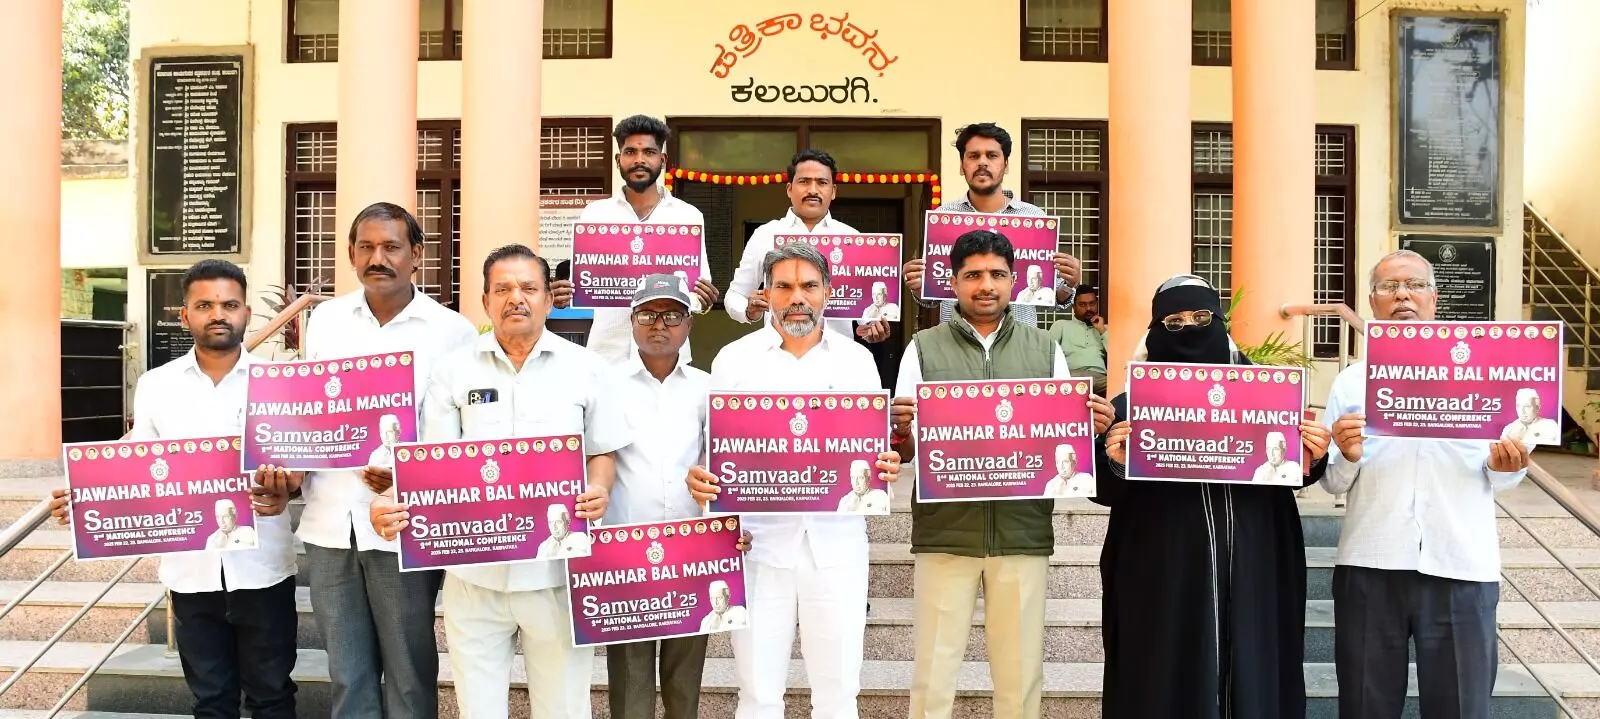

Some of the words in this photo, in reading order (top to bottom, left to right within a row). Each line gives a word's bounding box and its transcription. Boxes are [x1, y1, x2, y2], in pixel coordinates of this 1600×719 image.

[575, 254, 630, 265] JAWAHAR
[633, 255, 653, 265] BAL
[656, 255, 698, 266] MANCH
[833, 266, 851, 276] BAL
[855, 266, 897, 277] MANCH
[1369, 365, 1448, 380] JAWAHAR
[1454, 366, 1483, 380] BAL
[1489, 367, 1555, 381] MANCH
[249, 401, 323, 416] JAWAHAR
[328, 399, 352, 413] BAL
[357, 392, 412, 410] MANCH
[1133, 406, 1206, 422] JAWAHAR
[1211, 409, 1237, 423] BAL
[1242, 410, 1299, 425] MANCH
[921, 425, 994, 441] JAWAHAR
[999, 424, 1026, 439] BAL
[1030, 422, 1088, 438] MANCH
[315, 443, 359, 452] CONFERENCE
[713, 438, 788, 453] JAWAHAR
[794, 438, 820, 452] BAL
[826, 438, 884, 452] MANCH
[989, 472, 1035, 480] CONFERENCE
[74, 484, 151, 502] JAWAHAR
[156, 482, 183, 497] BAL
[188, 477, 247, 494] MANCH
[401, 487, 481, 507] JAWAHAR
[486, 485, 515, 501] BAL
[519, 480, 581, 498] MANCH
[106, 531, 145, 540] NATIONAL
[148, 527, 195, 537] CONFERENCE
[434, 538, 474, 548] NATIONAL
[477, 534, 526, 545] CONFERENCE
[572, 568, 647, 589] JAWAHAR
[651, 565, 678, 580] BAL
[683, 558, 740, 577] MANCH
[603, 615, 641, 626] NATIONAL
[644, 610, 690, 621] CONFERENCE
